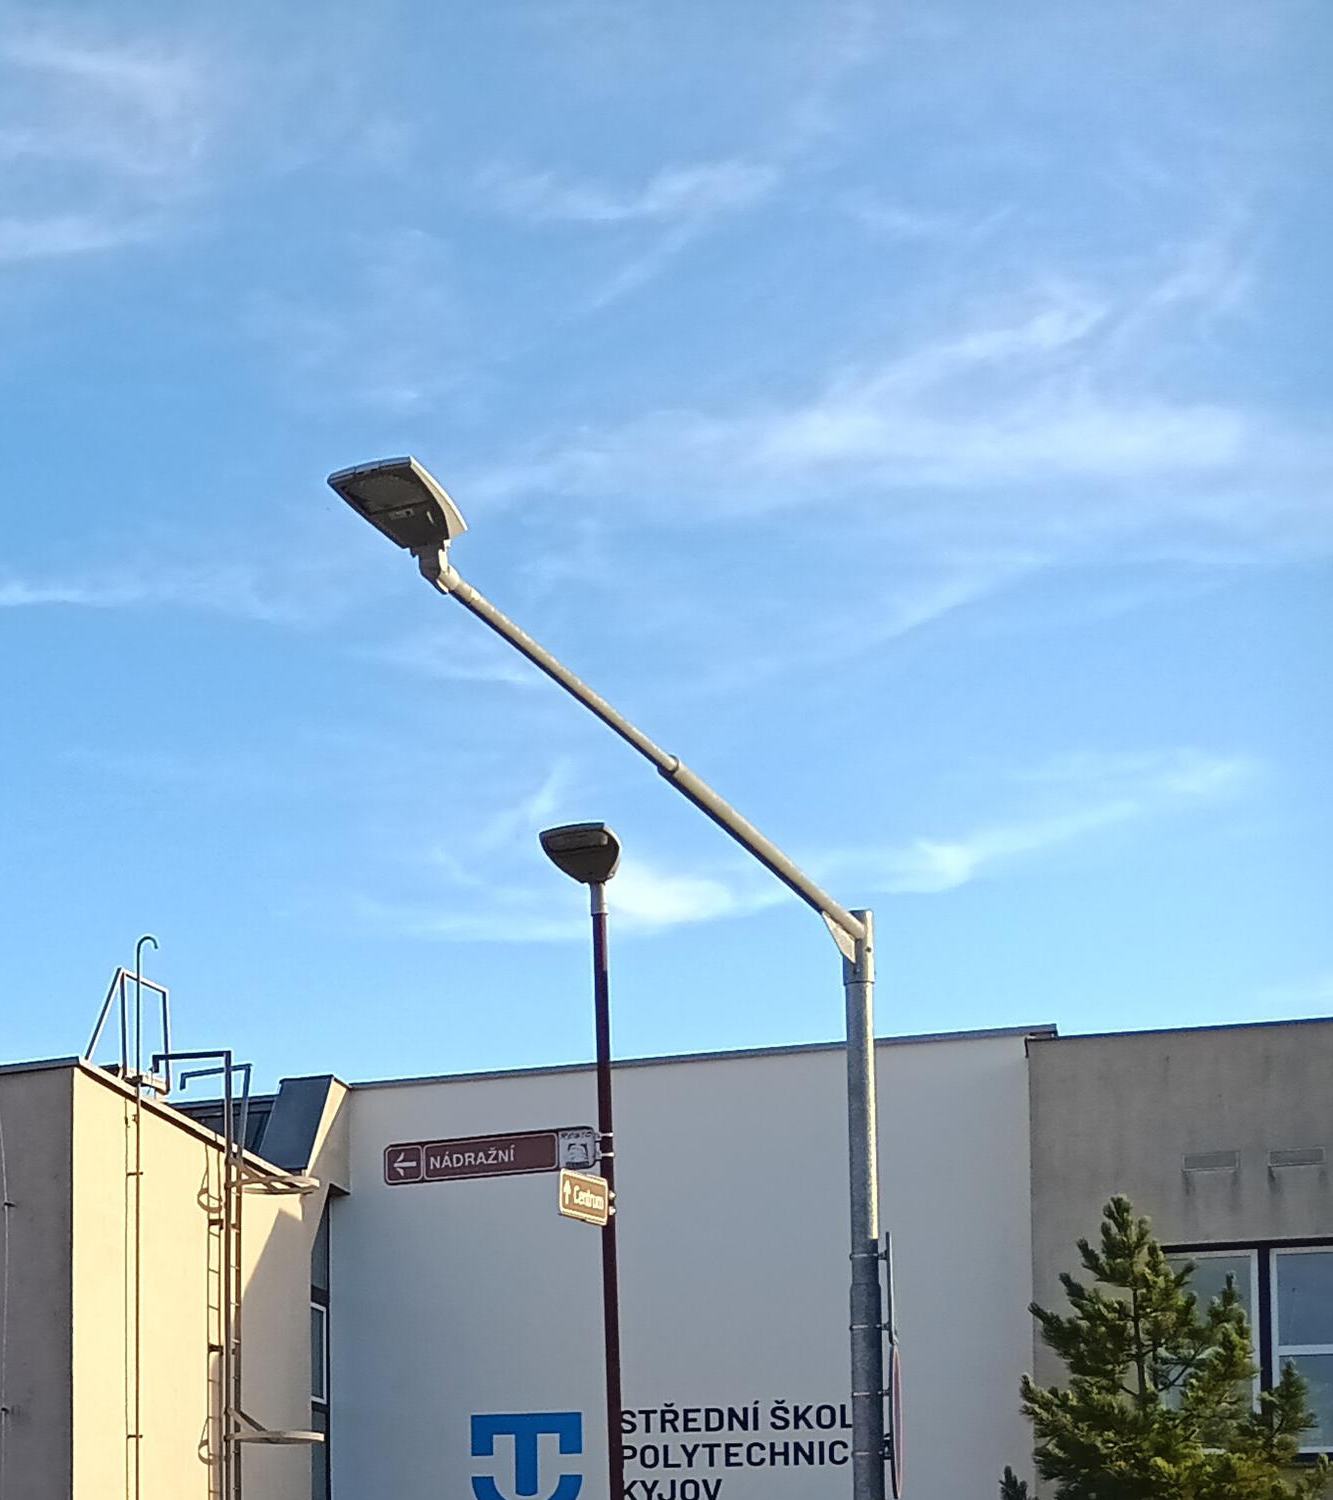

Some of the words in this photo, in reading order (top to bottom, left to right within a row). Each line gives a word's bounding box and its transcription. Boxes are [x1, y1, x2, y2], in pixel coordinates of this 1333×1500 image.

[429, 1144, 515, 1170] NÁDRAŽNÍ
[573, 1184, 605, 1211] Centrum
[620, 1400, 760, 1434] STŘEDNÍ
[770, 1400, 853, 1431] ŠKOL
[622, 1434, 891, 1469] POLYTECHNIC
